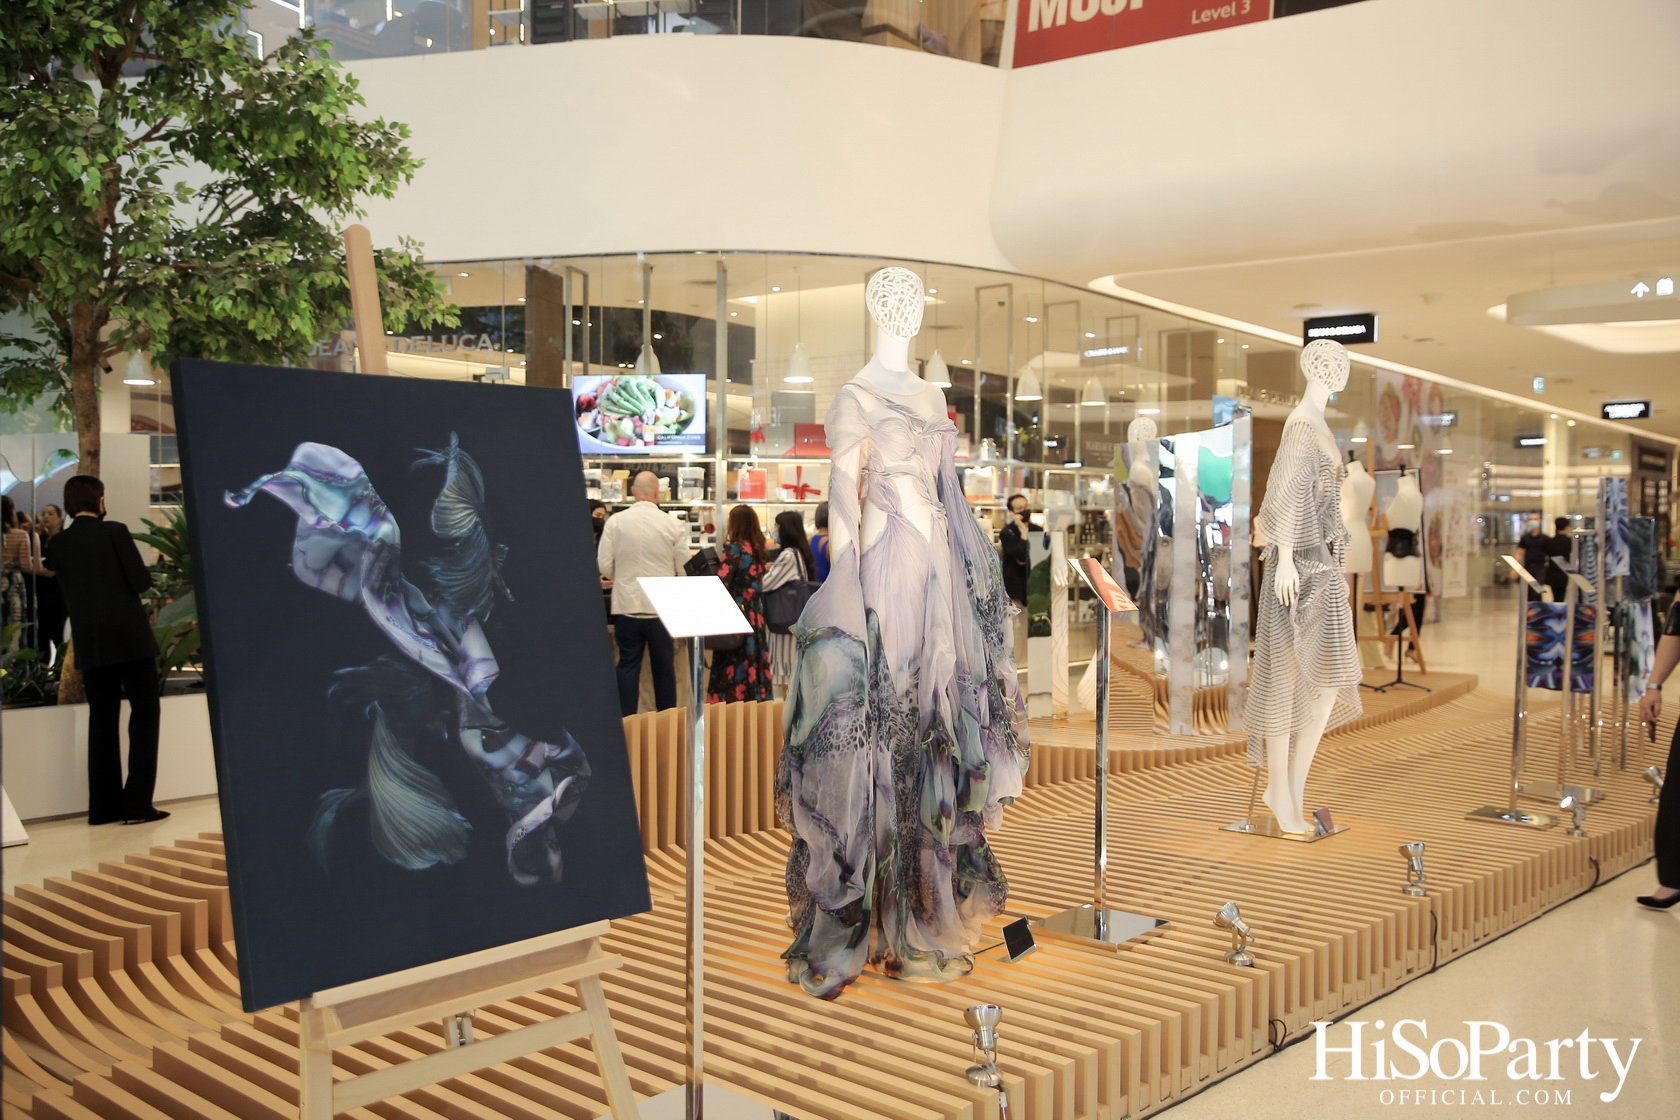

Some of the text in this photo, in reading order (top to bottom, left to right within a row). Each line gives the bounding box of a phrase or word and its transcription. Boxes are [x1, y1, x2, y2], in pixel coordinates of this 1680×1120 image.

[1191, 0, 1250, 25] Level 3
[393, 333, 495, 353] DELUCA
